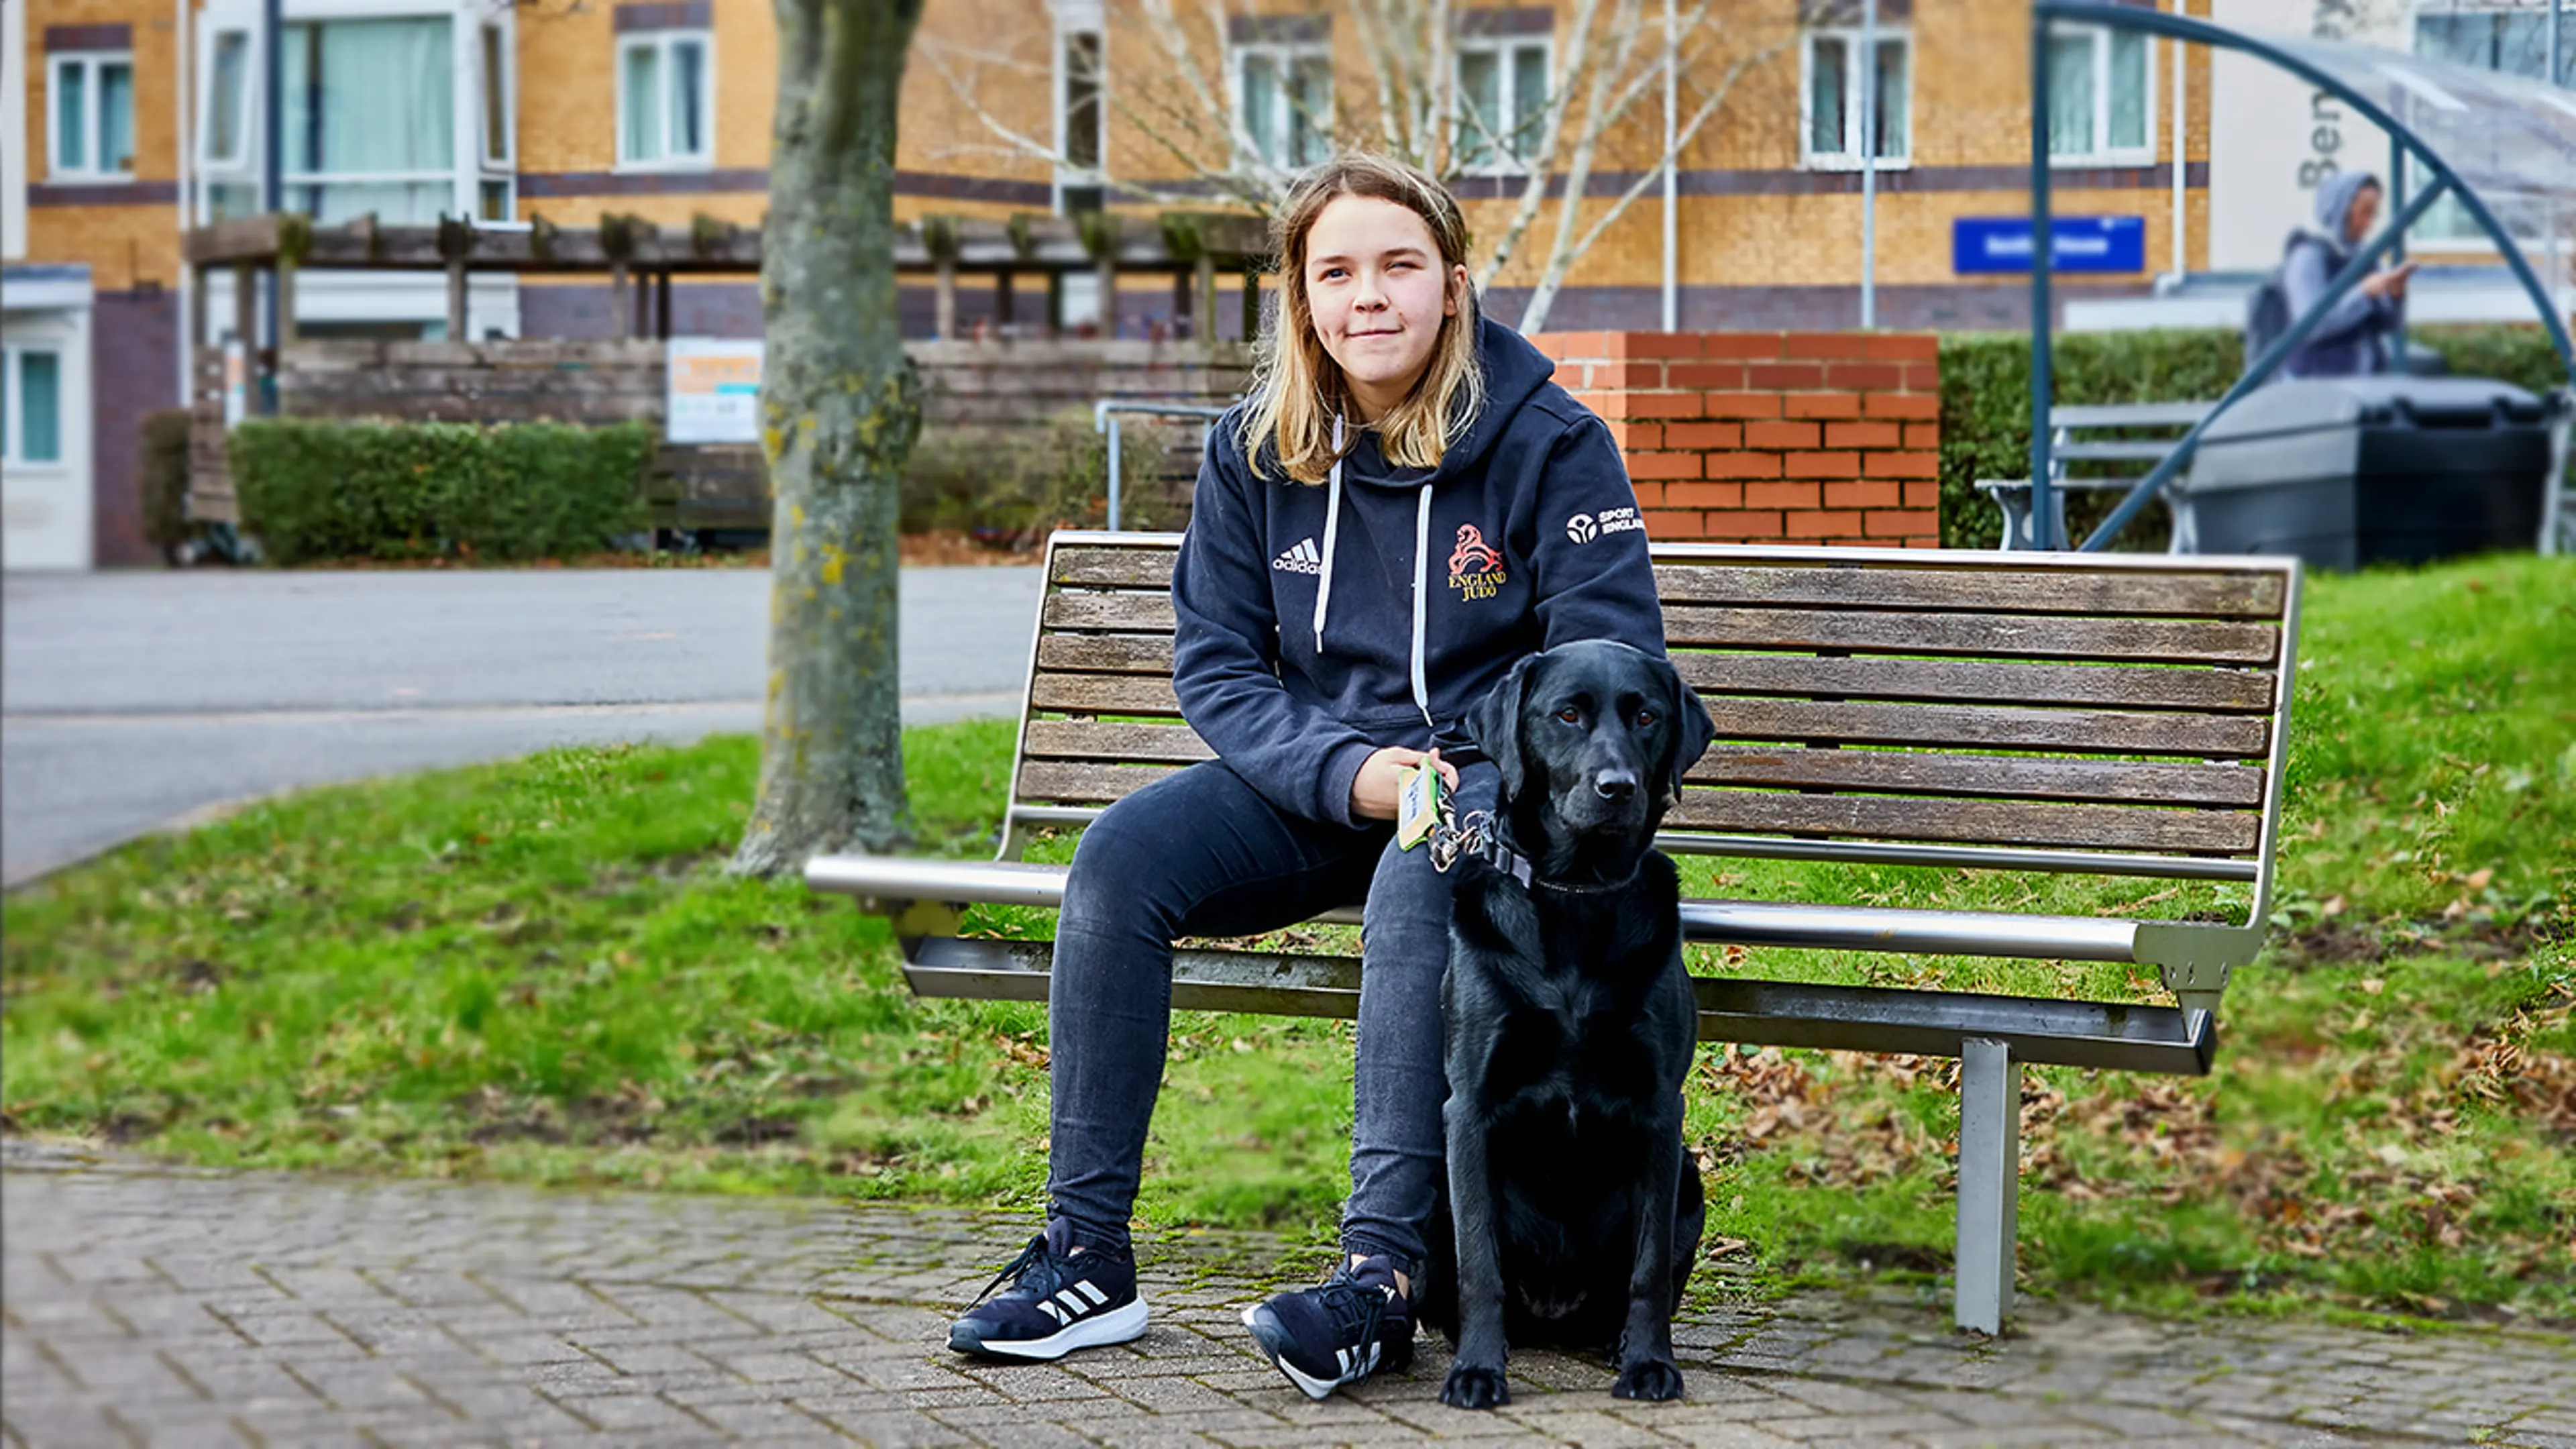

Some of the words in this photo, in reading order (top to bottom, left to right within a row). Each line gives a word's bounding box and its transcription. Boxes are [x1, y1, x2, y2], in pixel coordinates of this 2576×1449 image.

[1598, 508, 1633, 523] SPORT
[1449, 572, 1506, 588] ENGLAND
[1462, 586, 1497, 602] JUDO
